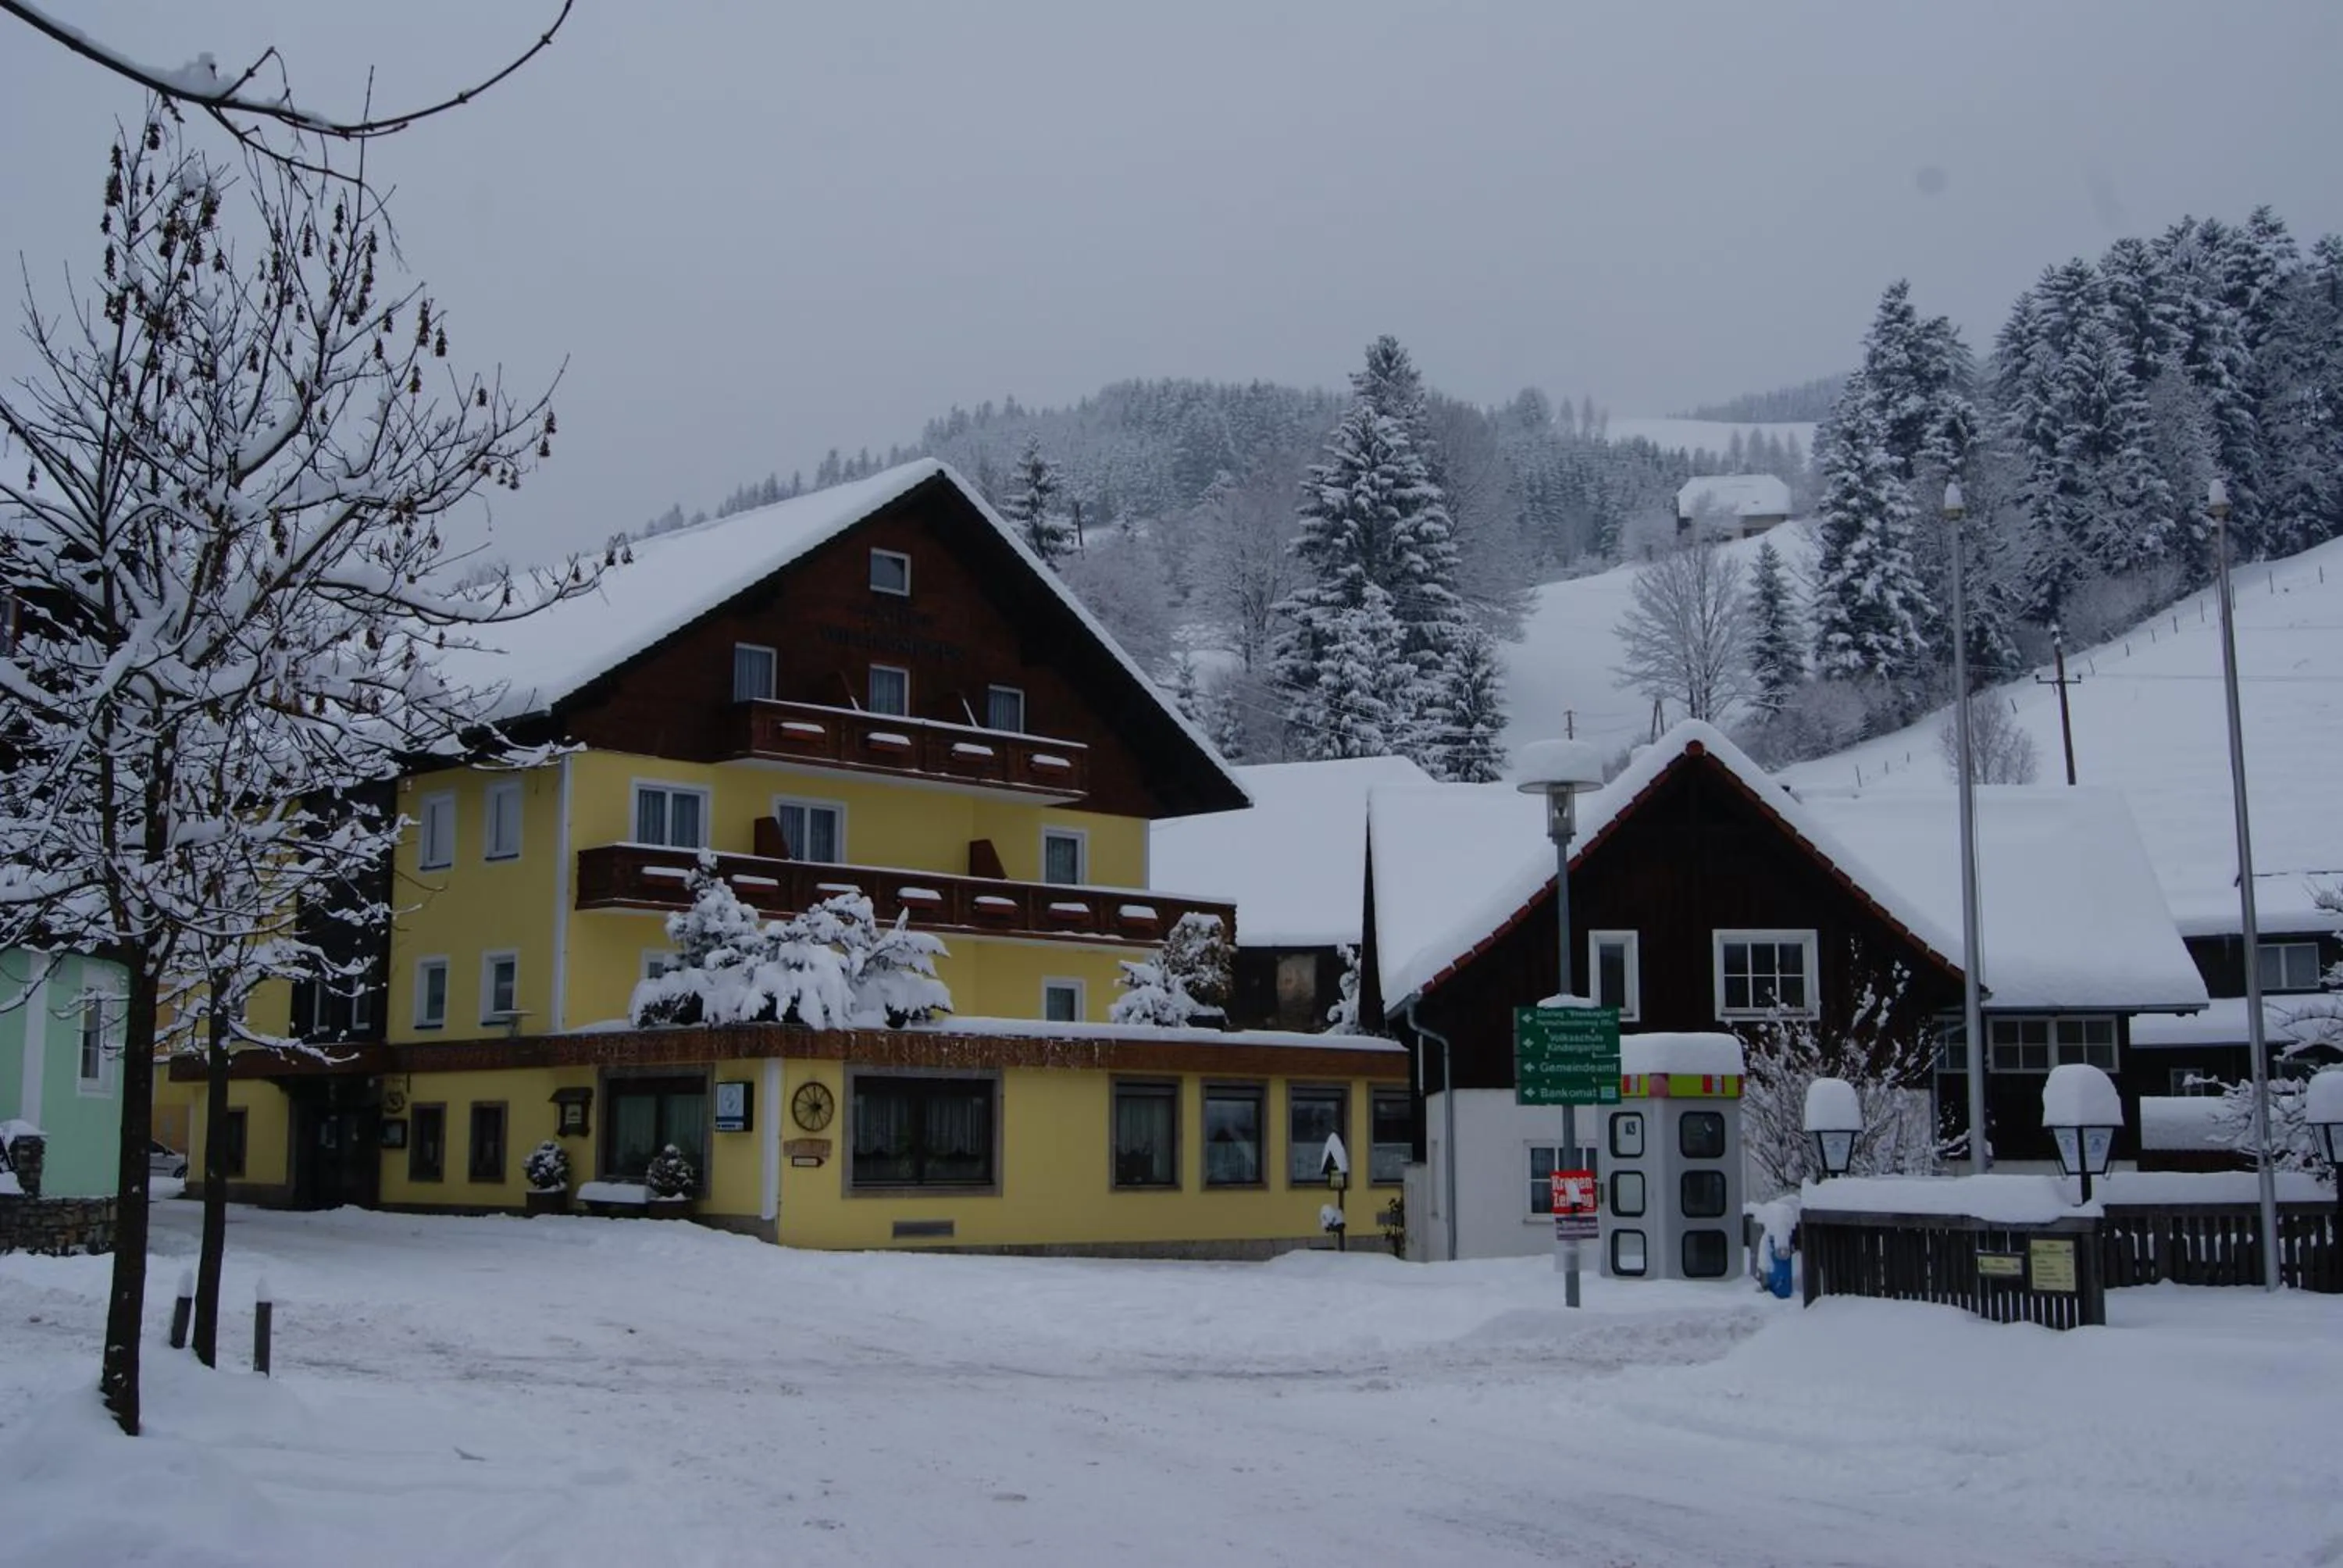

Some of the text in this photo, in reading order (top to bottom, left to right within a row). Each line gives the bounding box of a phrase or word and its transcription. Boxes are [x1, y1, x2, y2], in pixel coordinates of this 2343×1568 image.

[1547, 1042, 1607, 1053] Kindergarten
[1539, 1061, 1617, 1072] Gemeindeamt
[1540, 1087, 1597, 1098] Bankomat
